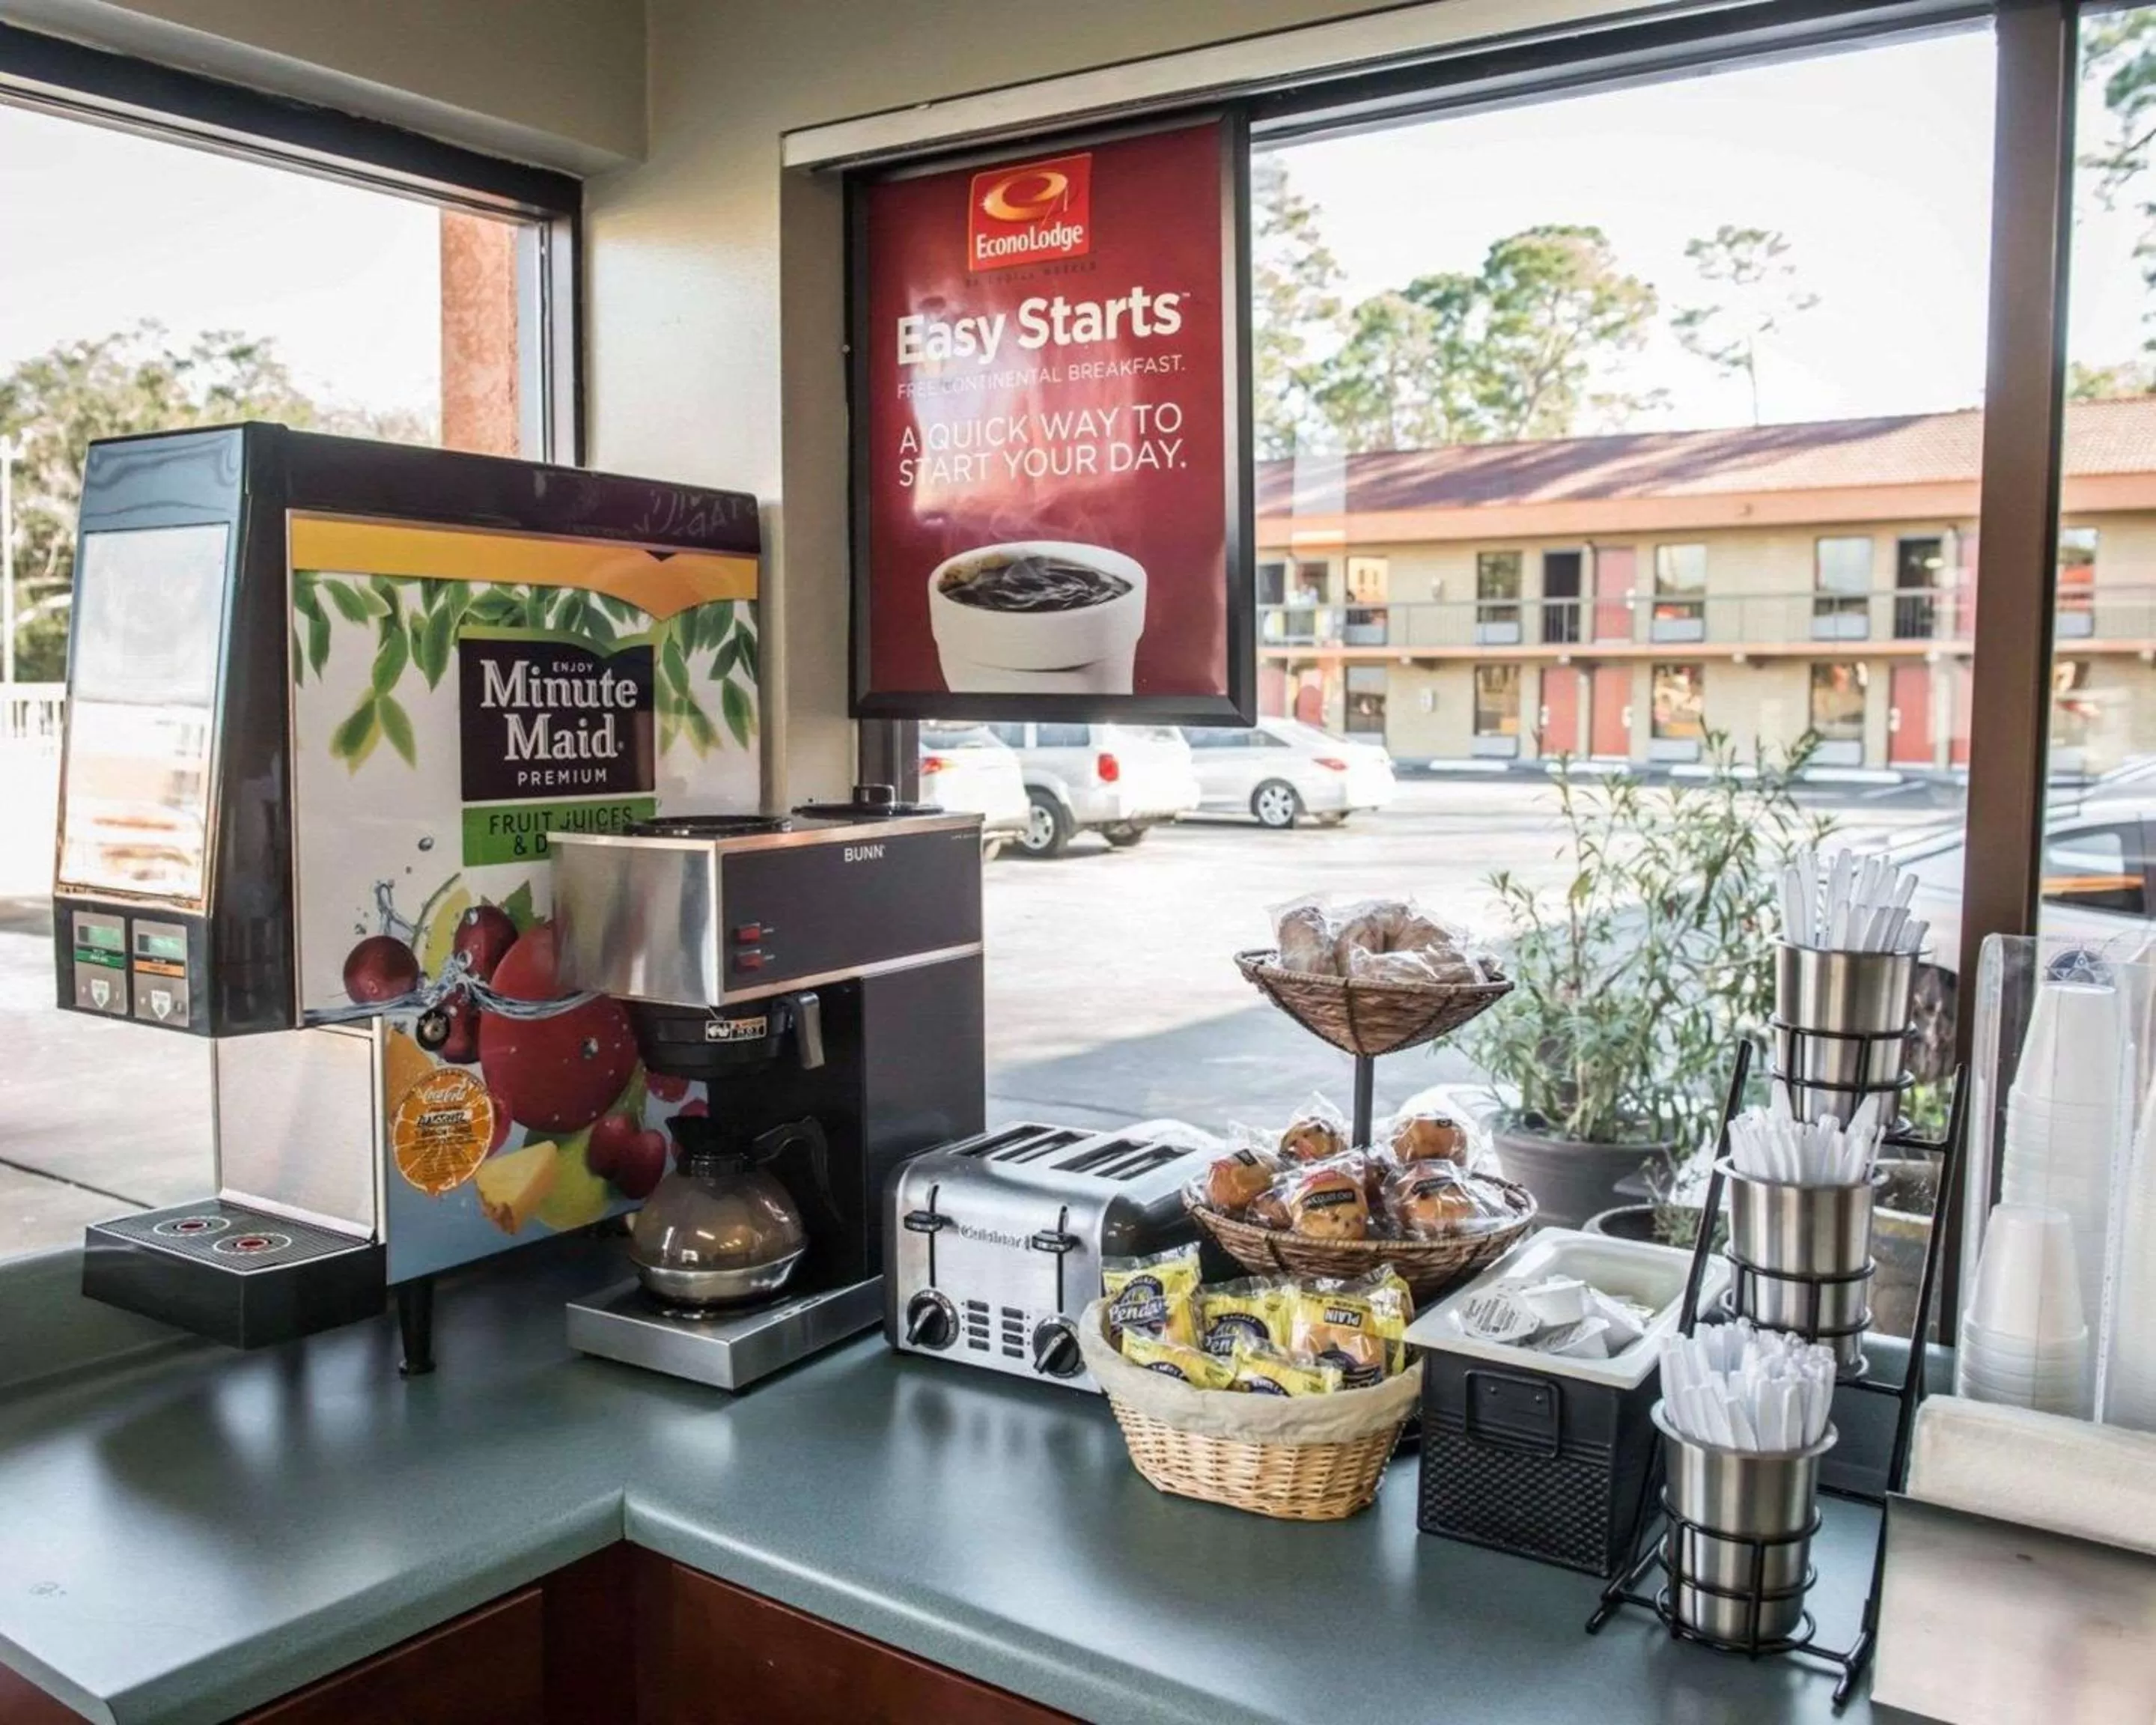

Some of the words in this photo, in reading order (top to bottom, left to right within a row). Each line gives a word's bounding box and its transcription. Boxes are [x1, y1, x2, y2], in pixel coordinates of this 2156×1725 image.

[976, 222, 1083, 259] EconoLodge
[898, 314, 1006, 365] Easy
[1018, 286, 1182, 349] Starts
[898, 380, 937, 399] FREE
[943, 367, 1062, 394] CONTINENTAL
[1069, 355, 1186, 382] BREAKFAST.
[900, 427, 918, 455] A
[928, 415, 1029, 451] QUICK
[1038, 407, 1118, 439] WAY
[1132, 402, 1183, 434] TO
[900, 454, 992, 487] START
[1003, 445, 1098, 478] YOUR
[1109, 439, 1187, 472] DAY.
[480, 659, 638, 708] Minute
[552, 661, 594, 673] ENJOY
[504, 713, 618, 761] Maid
[517, 768, 607, 786] PREMIUM
[490, 810, 553, 836] FRUIT
[514, 834, 527, 856] &
[844, 845, 884, 862] BUNN
[1324, 1309, 1360, 1327] PLAIN
